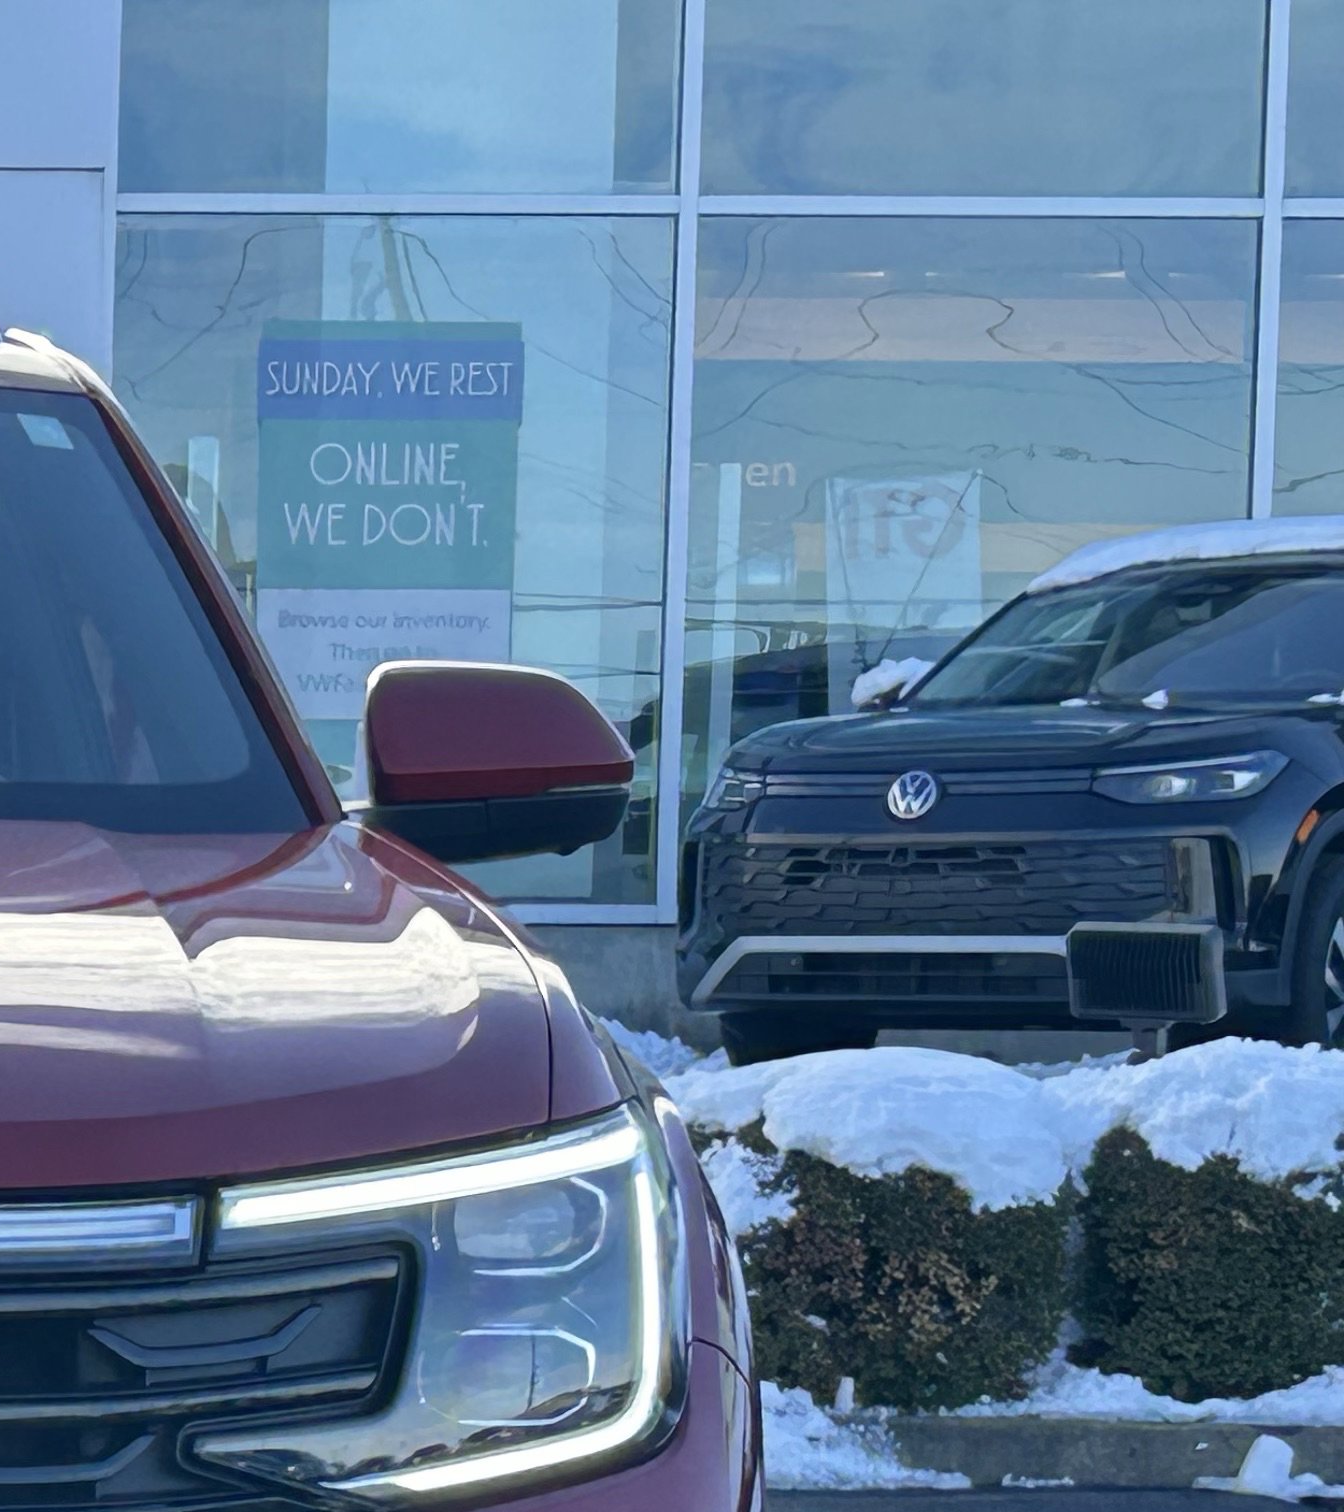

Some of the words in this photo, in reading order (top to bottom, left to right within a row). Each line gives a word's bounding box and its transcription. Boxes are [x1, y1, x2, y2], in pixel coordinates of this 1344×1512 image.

[391, 361, 441, 396] WE
[450, 362, 513, 396] REST
[284, 502, 346, 545] WE
[278, 609, 349, 629] Browse
[355, 614, 388, 629] our
